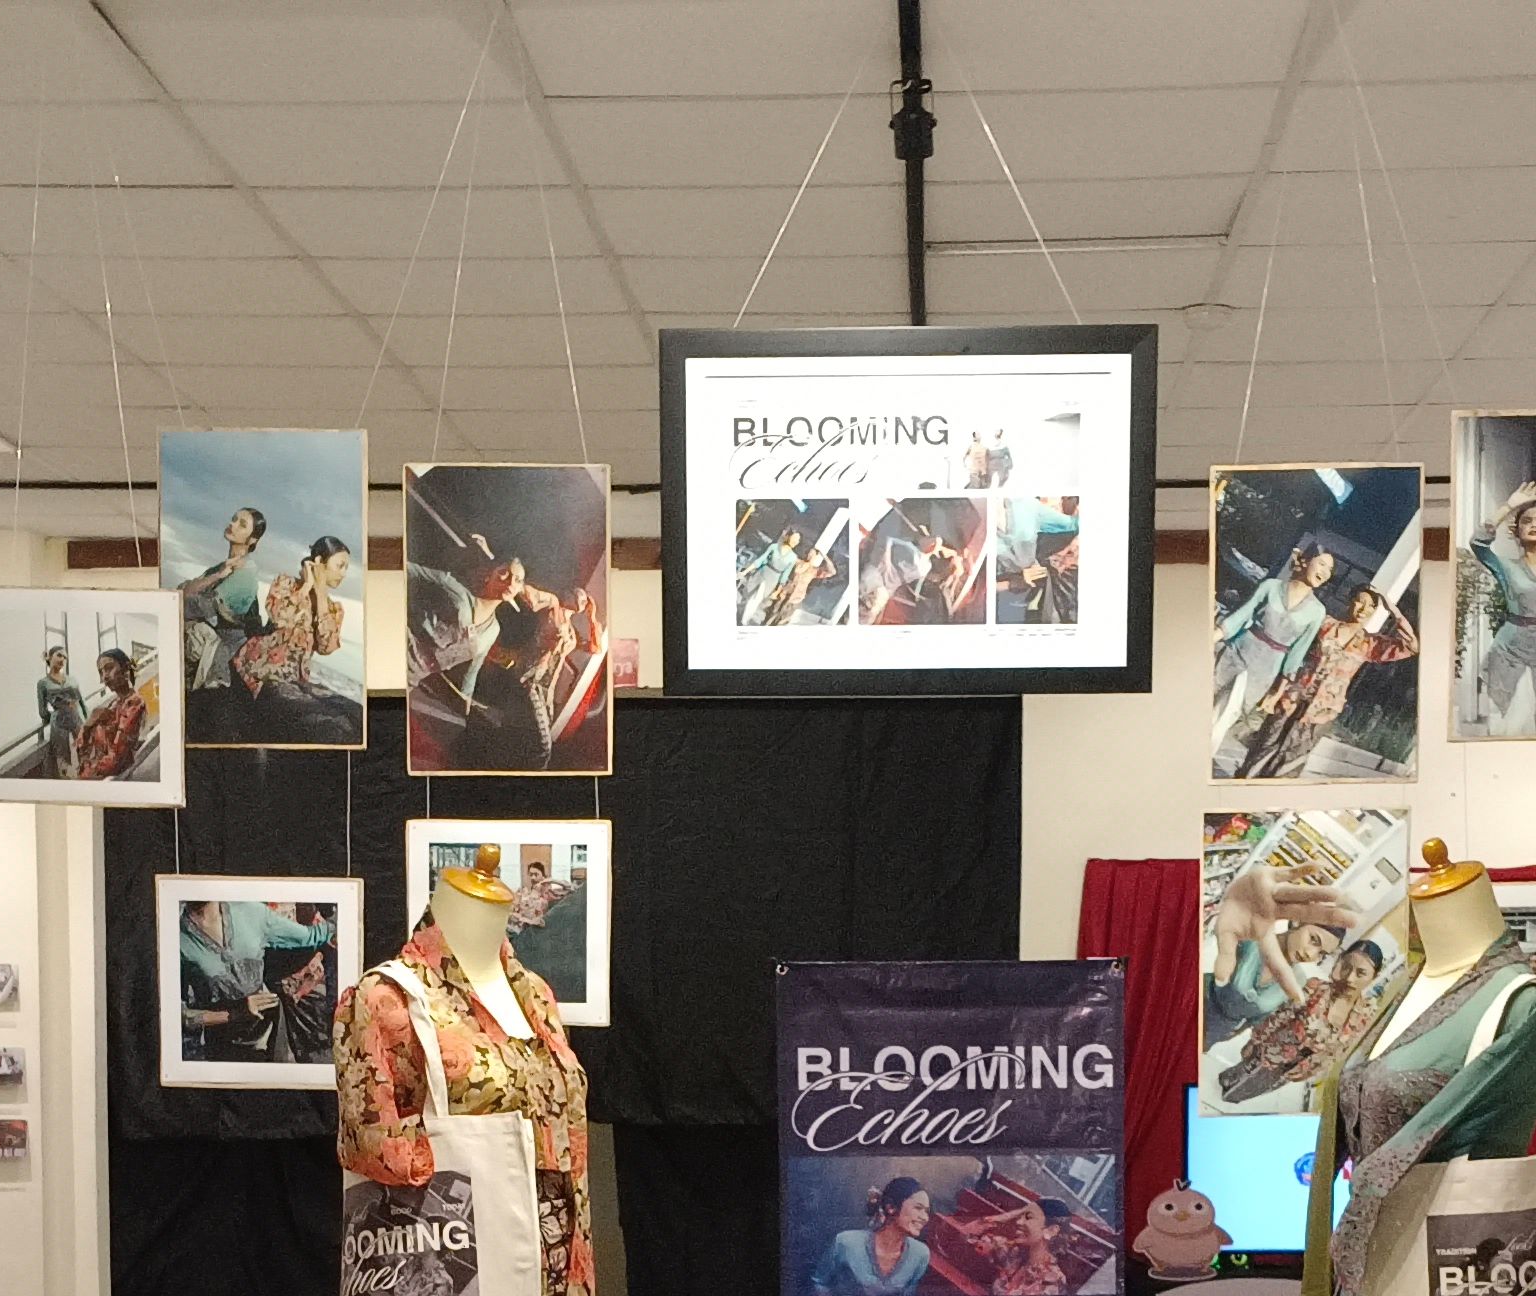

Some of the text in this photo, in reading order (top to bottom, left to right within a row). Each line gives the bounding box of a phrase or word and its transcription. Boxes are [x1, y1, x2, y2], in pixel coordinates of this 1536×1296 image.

[733, 415, 950, 448] BLOOMING
[796, 1043, 1115, 1092] BLOOMING
[791, 1052, 1026, 1152] Echoes
[344, 1221, 471, 1265] OOMING
